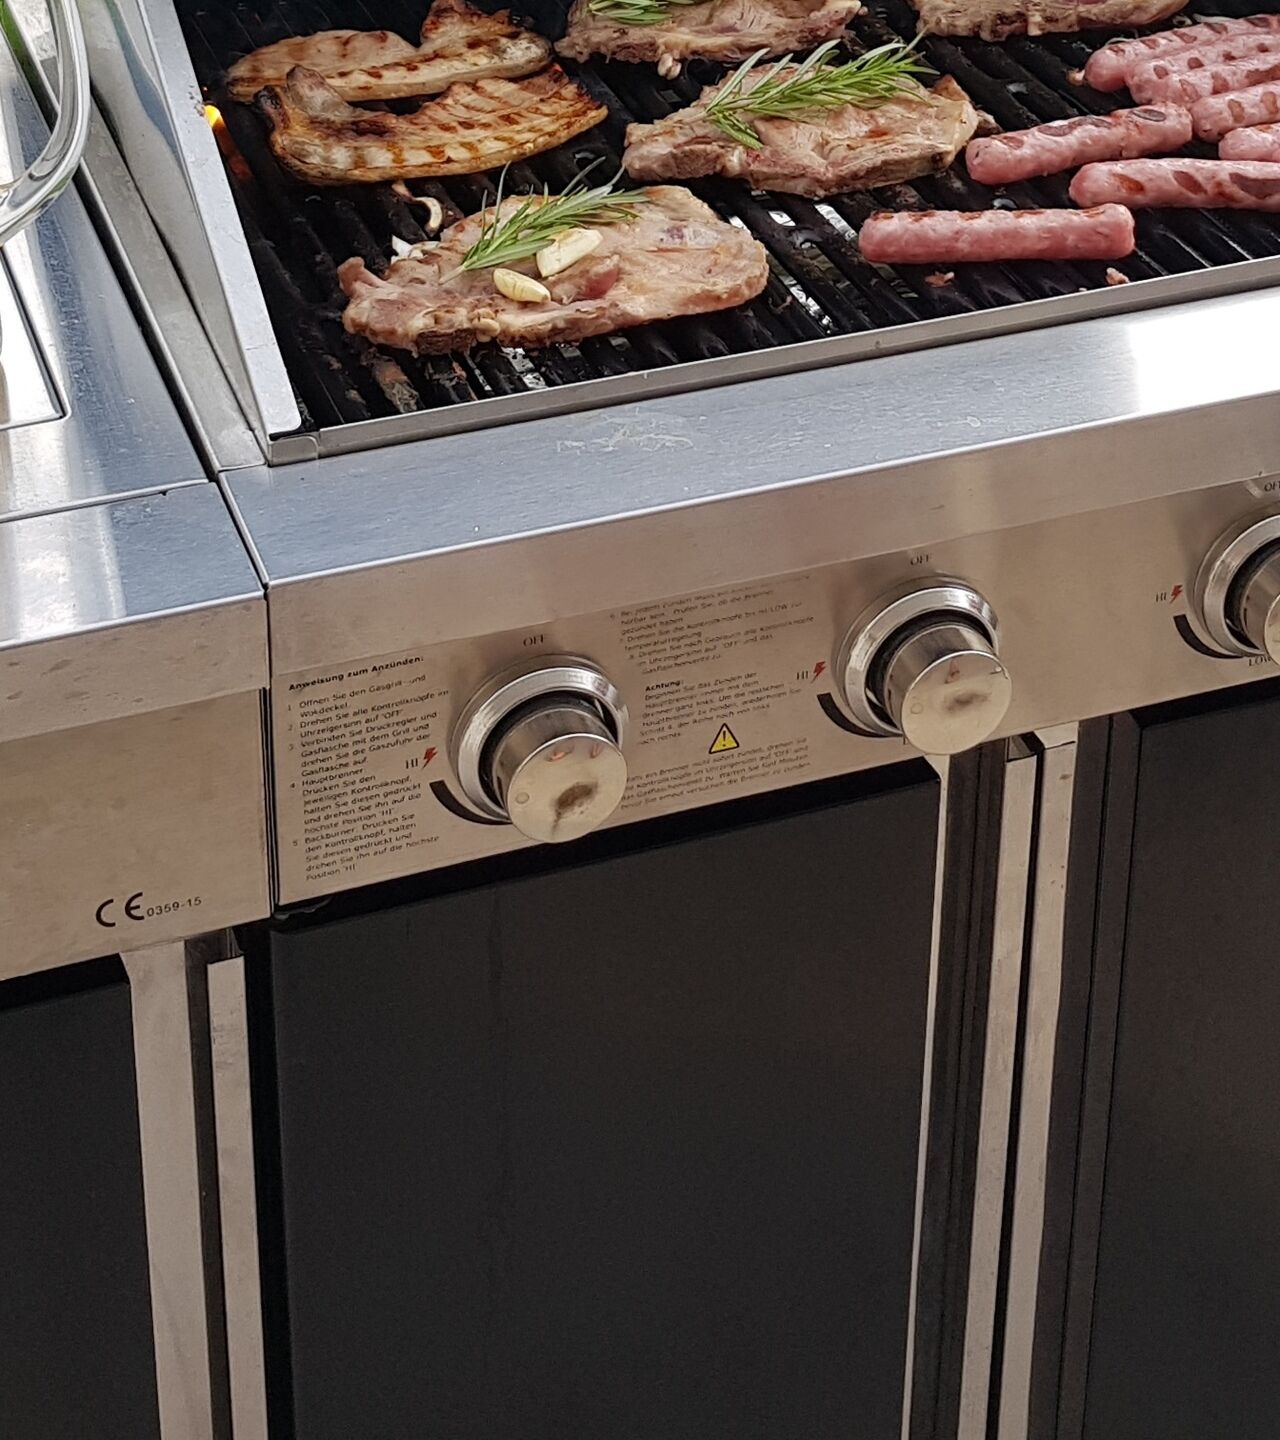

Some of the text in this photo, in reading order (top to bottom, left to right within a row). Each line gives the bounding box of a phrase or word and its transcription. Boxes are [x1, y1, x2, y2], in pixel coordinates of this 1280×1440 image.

[910, 554, 932, 566] OFF
[523, 634, 544, 647] OFF
[346, 668, 368, 678] zum
[404, 758, 418, 769] HI
[146, 896, 202, 917] 0359-15
